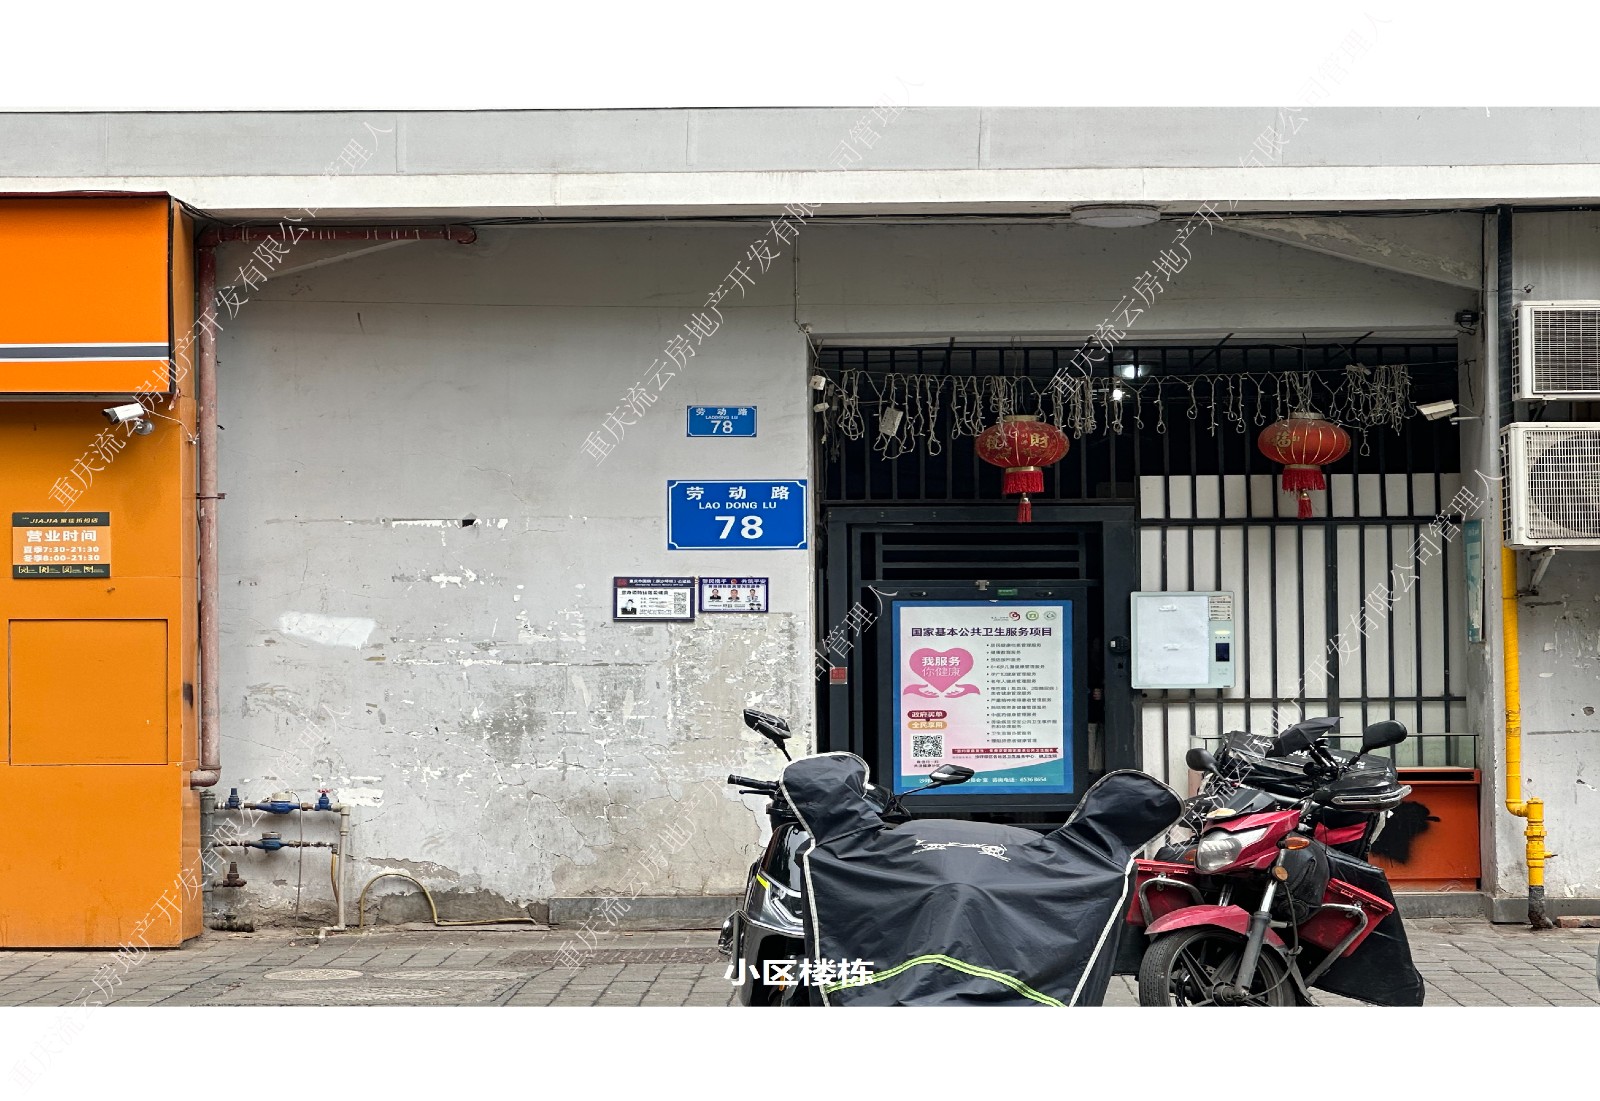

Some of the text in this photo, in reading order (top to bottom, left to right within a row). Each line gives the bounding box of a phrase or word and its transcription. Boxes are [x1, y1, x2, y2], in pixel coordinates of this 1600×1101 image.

[696, 408, 748, 416] 劳动路
[711, 420, 733, 433] 78
[686, 486, 790, 500] 劳动路
[698, 501, 777, 509] LAO DONG LU
[715, 515, 764, 539] 78
[26, 530, 97, 542] 营业时间
[911, 627, 1052, 637] 国家基本公共卫生服务项目
[922, 656, 961, 666] 我服务
[922, 667, 961, 677] 你健康
